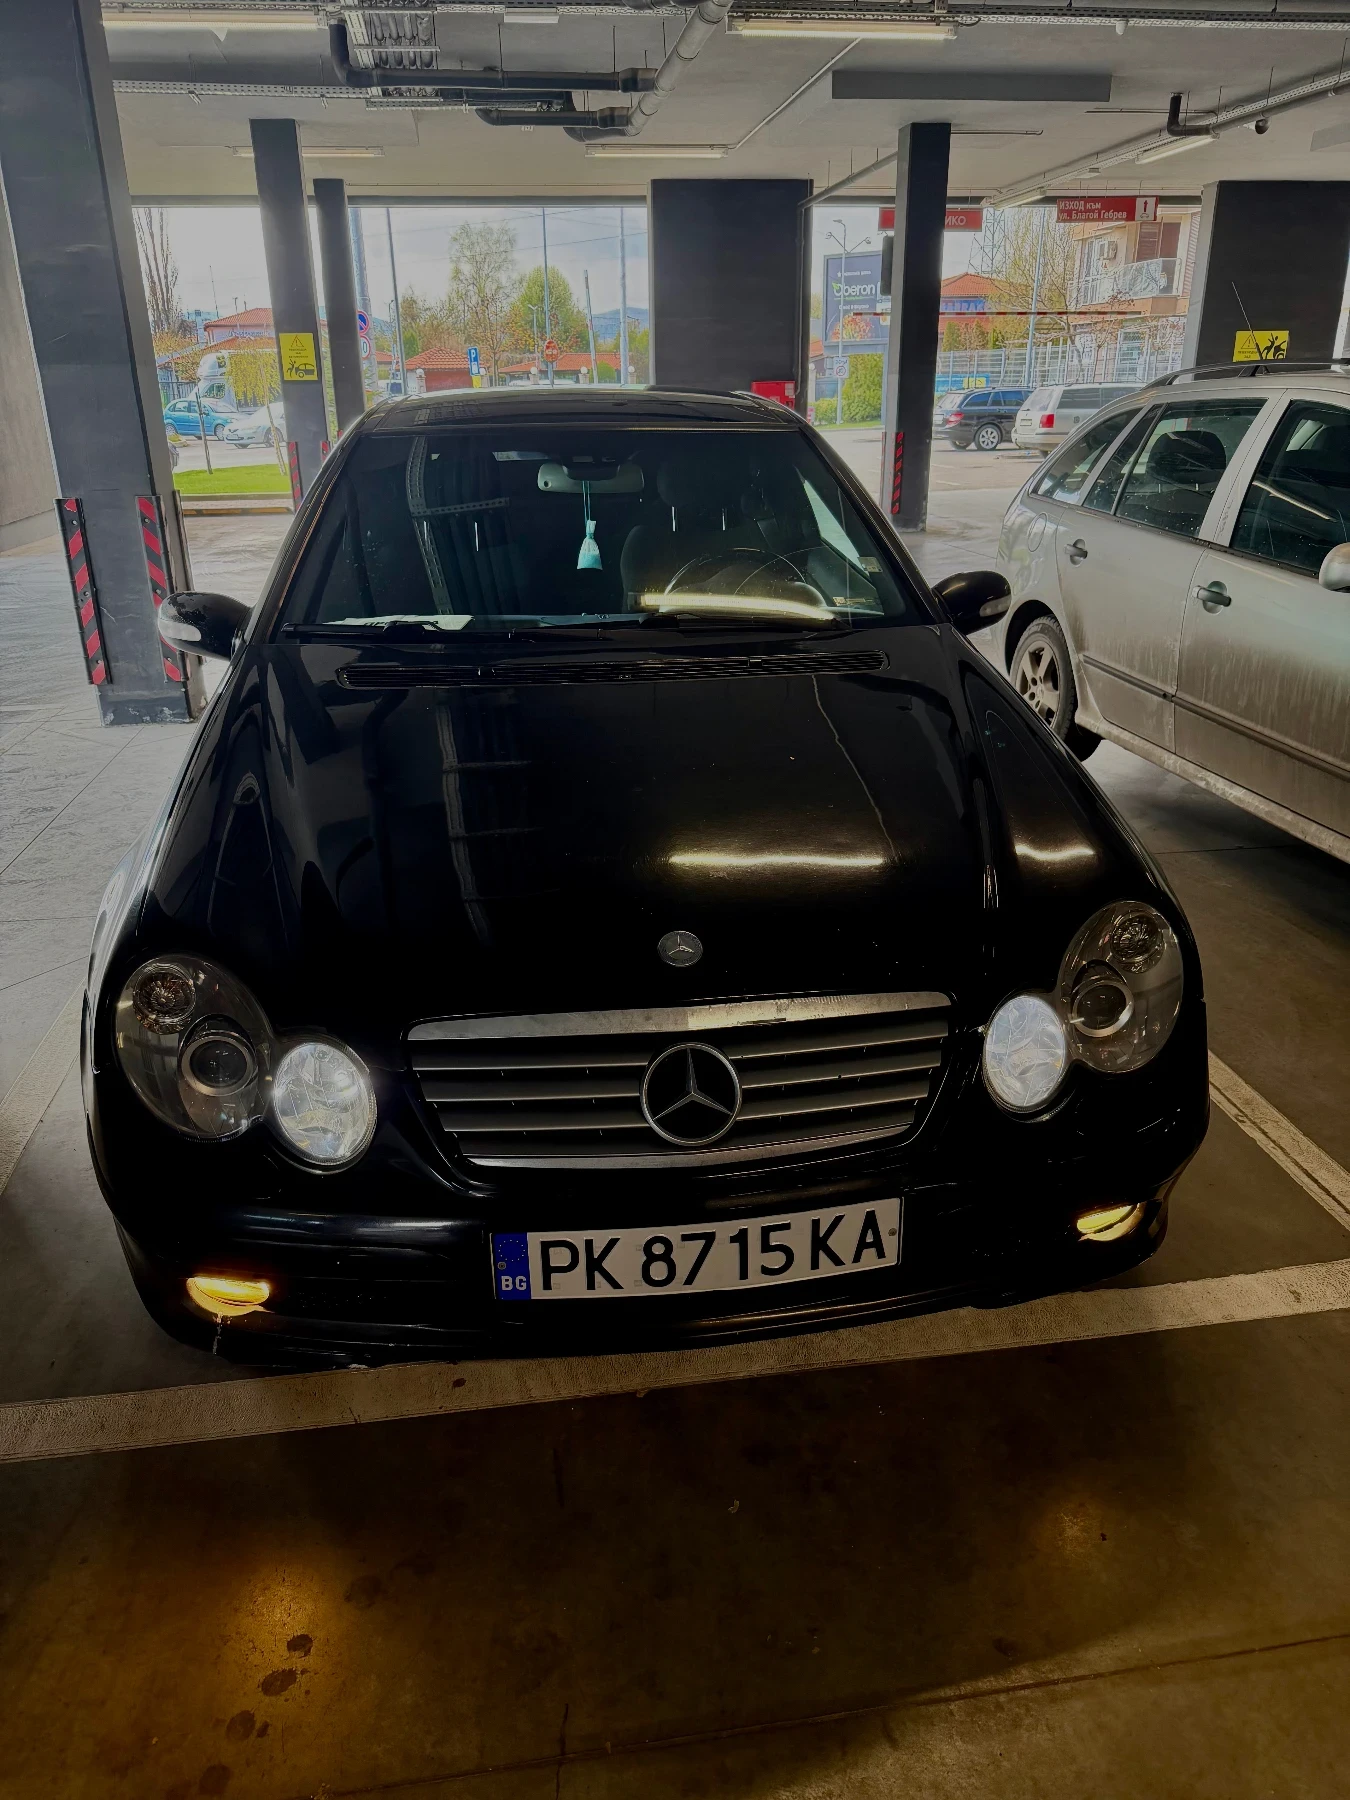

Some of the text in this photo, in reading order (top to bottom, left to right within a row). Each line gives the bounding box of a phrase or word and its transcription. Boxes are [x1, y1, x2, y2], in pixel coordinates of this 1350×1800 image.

[1059, 201, 1101, 211] ИЗХОД към
[945, 215, 967, 226] ИКО
[1058, 209, 1127, 221] ул. Благой Гебрев
[833, 283, 876, 297] Oberon
[539, 1208, 887, 1291] PK 8715 KA
[501, 1275, 527, 1291] BG
